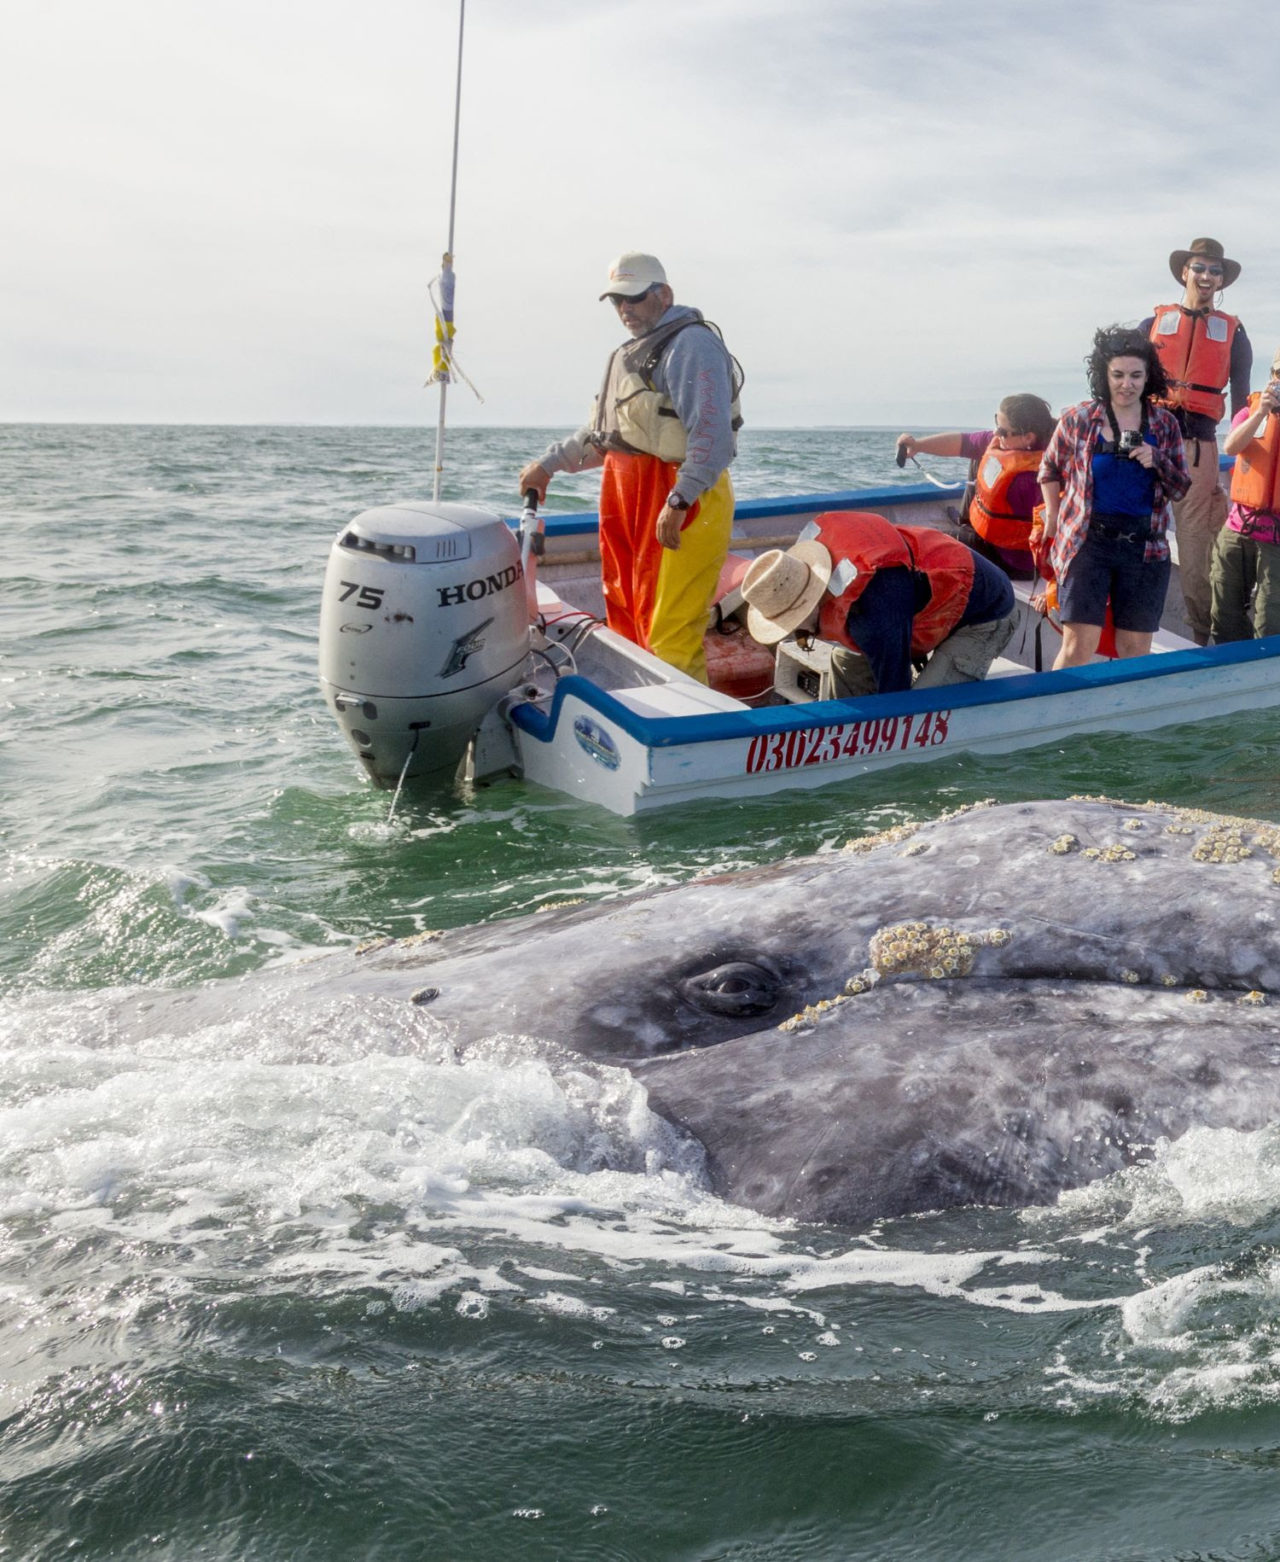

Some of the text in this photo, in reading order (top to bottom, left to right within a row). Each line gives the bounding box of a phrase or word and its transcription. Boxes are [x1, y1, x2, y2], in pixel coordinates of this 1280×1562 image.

[338, 580, 385, 610] 75
[436, 560, 524, 608] HONDA
[746, 710, 951, 774] 03023499148
